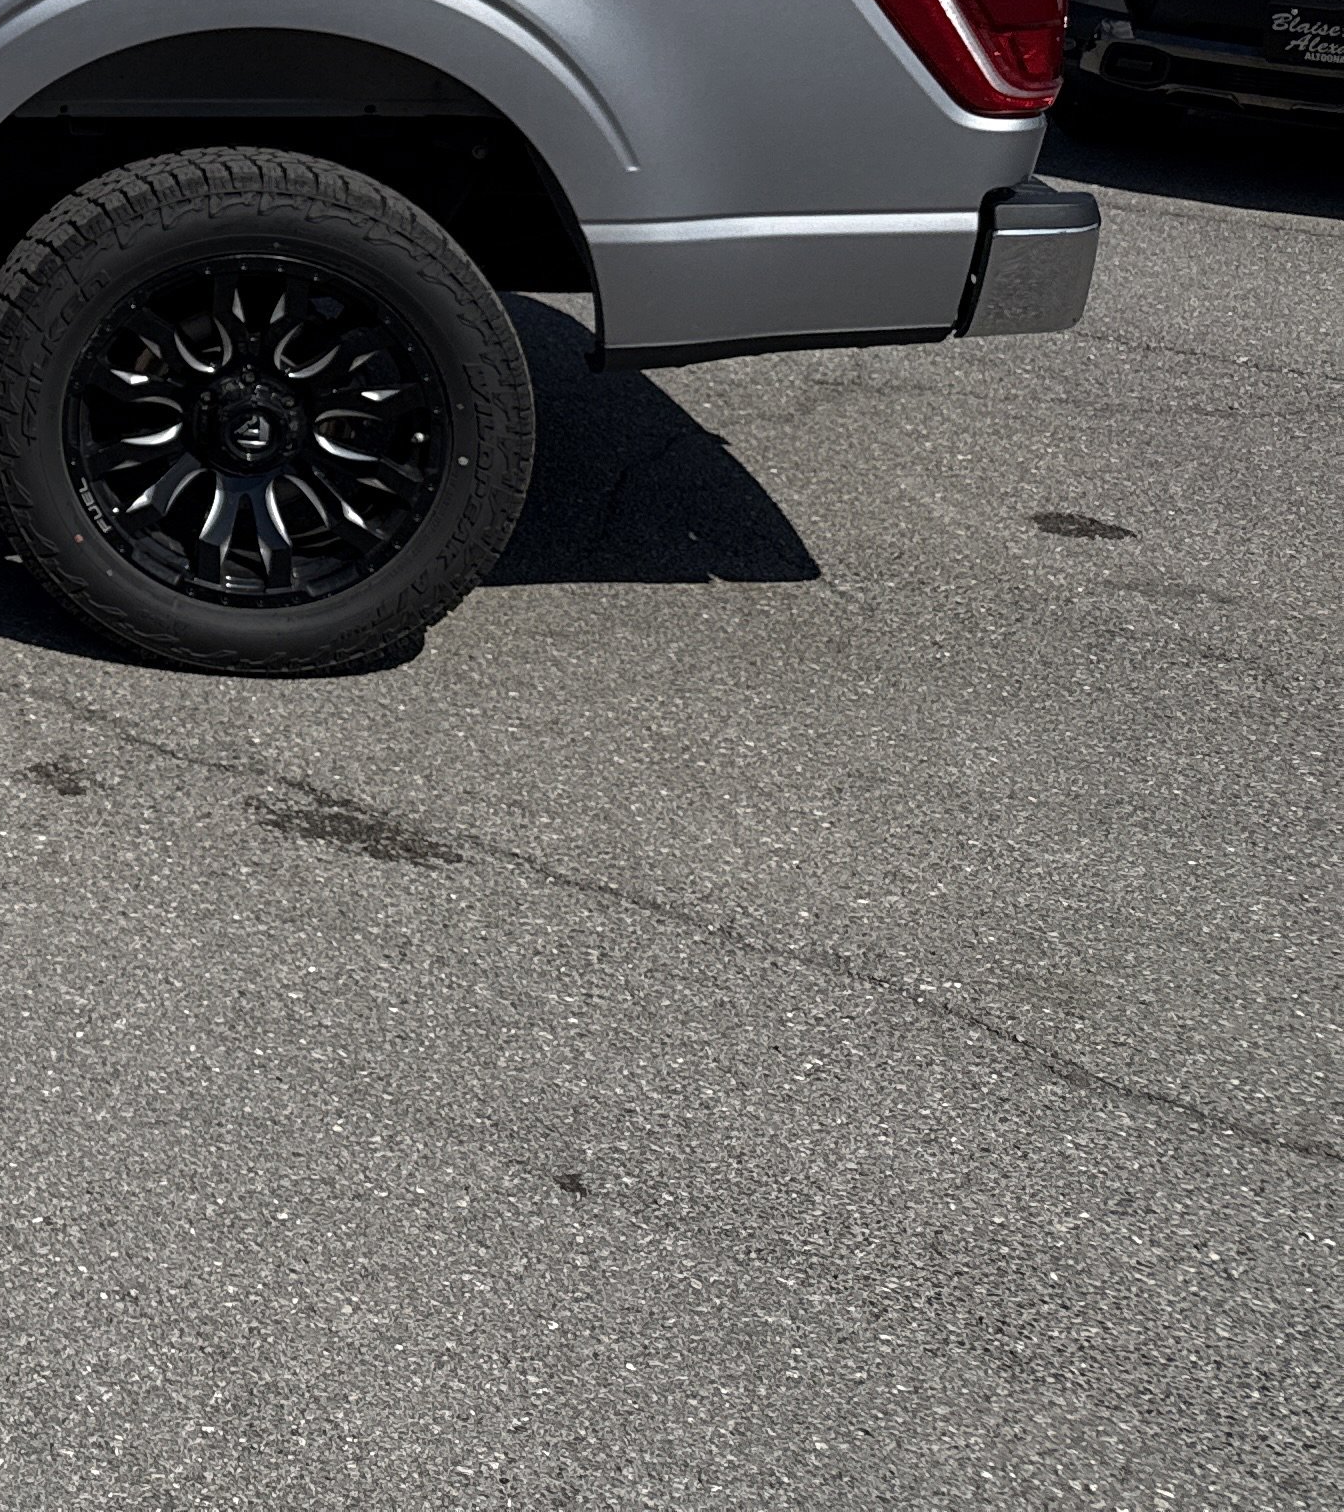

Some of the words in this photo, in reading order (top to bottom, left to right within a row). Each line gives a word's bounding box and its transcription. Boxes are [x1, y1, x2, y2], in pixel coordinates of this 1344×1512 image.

[1272, 13, 1341, 37] Blaise
[434, 362, 495, 571] WILDPEAK
[79, 476, 113, 534] FUEL
